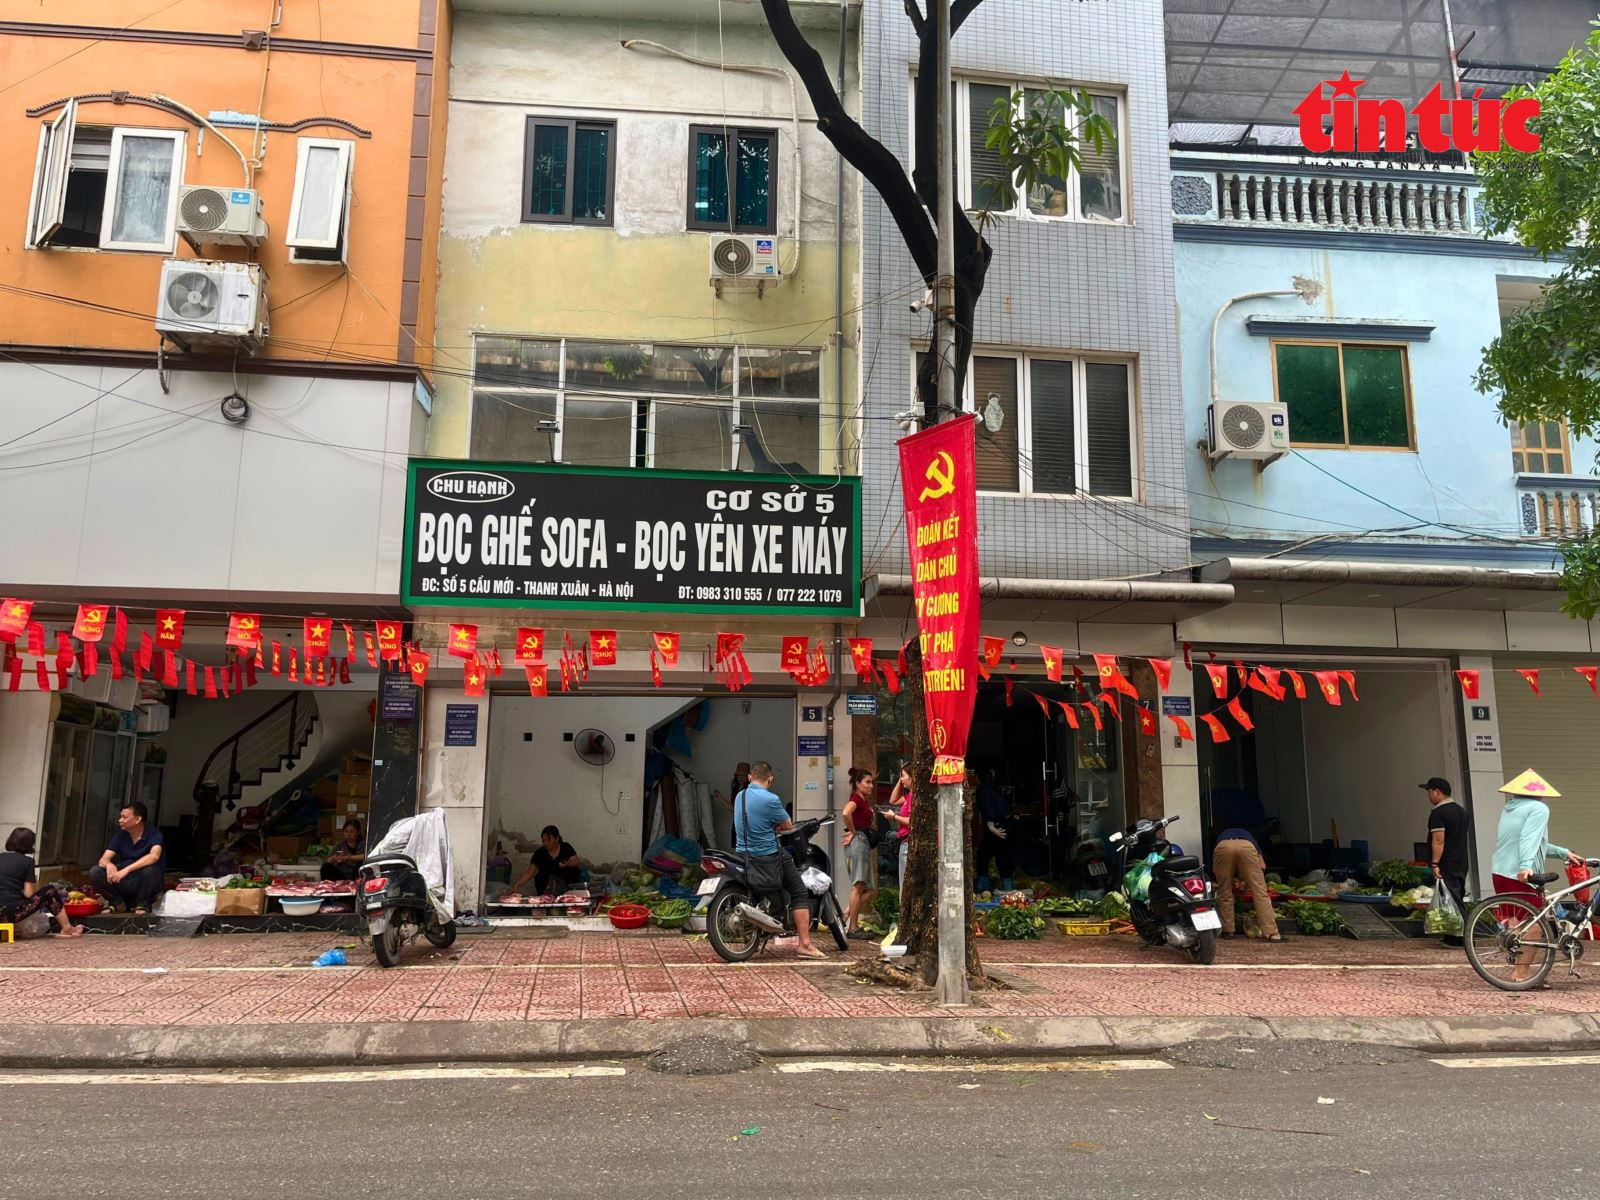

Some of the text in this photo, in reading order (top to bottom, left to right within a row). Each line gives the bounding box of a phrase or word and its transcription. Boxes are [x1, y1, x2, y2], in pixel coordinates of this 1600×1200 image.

[433, 478, 508, 497] CHU HẠNH
[706, 484, 835, 514] CƠ SỞ 5
[417, 498, 848, 582] BỌC GHẾ SOFA - BỌC YÊN XE MÁY
[916, 511, 960, 548] ĐOÀN KẾT
[938, 547, 957, 578] CHỦ
[421, 577, 440, 592] ĐC:
[442, 574, 458, 593] SỐ
[459, 579, 467, 593] 5
[493, 576, 514, 594] MỚI
[523, 580, 558, 596] THANH
[560, 580, 589, 597] XUÂN
[598, 580, 613, 597] HÀ
[615, 581, 634, 600] NỘI
[678, 585, 842, 603] ĐT: 0983 310 555 / 077 222 1079
[595, 650, 613, 658] CHÚC
[919, 626, 954, 660] ỘT PHÁ
[808, 709, 816, 720] 5
[1478, 708, 1485, 718] 9
